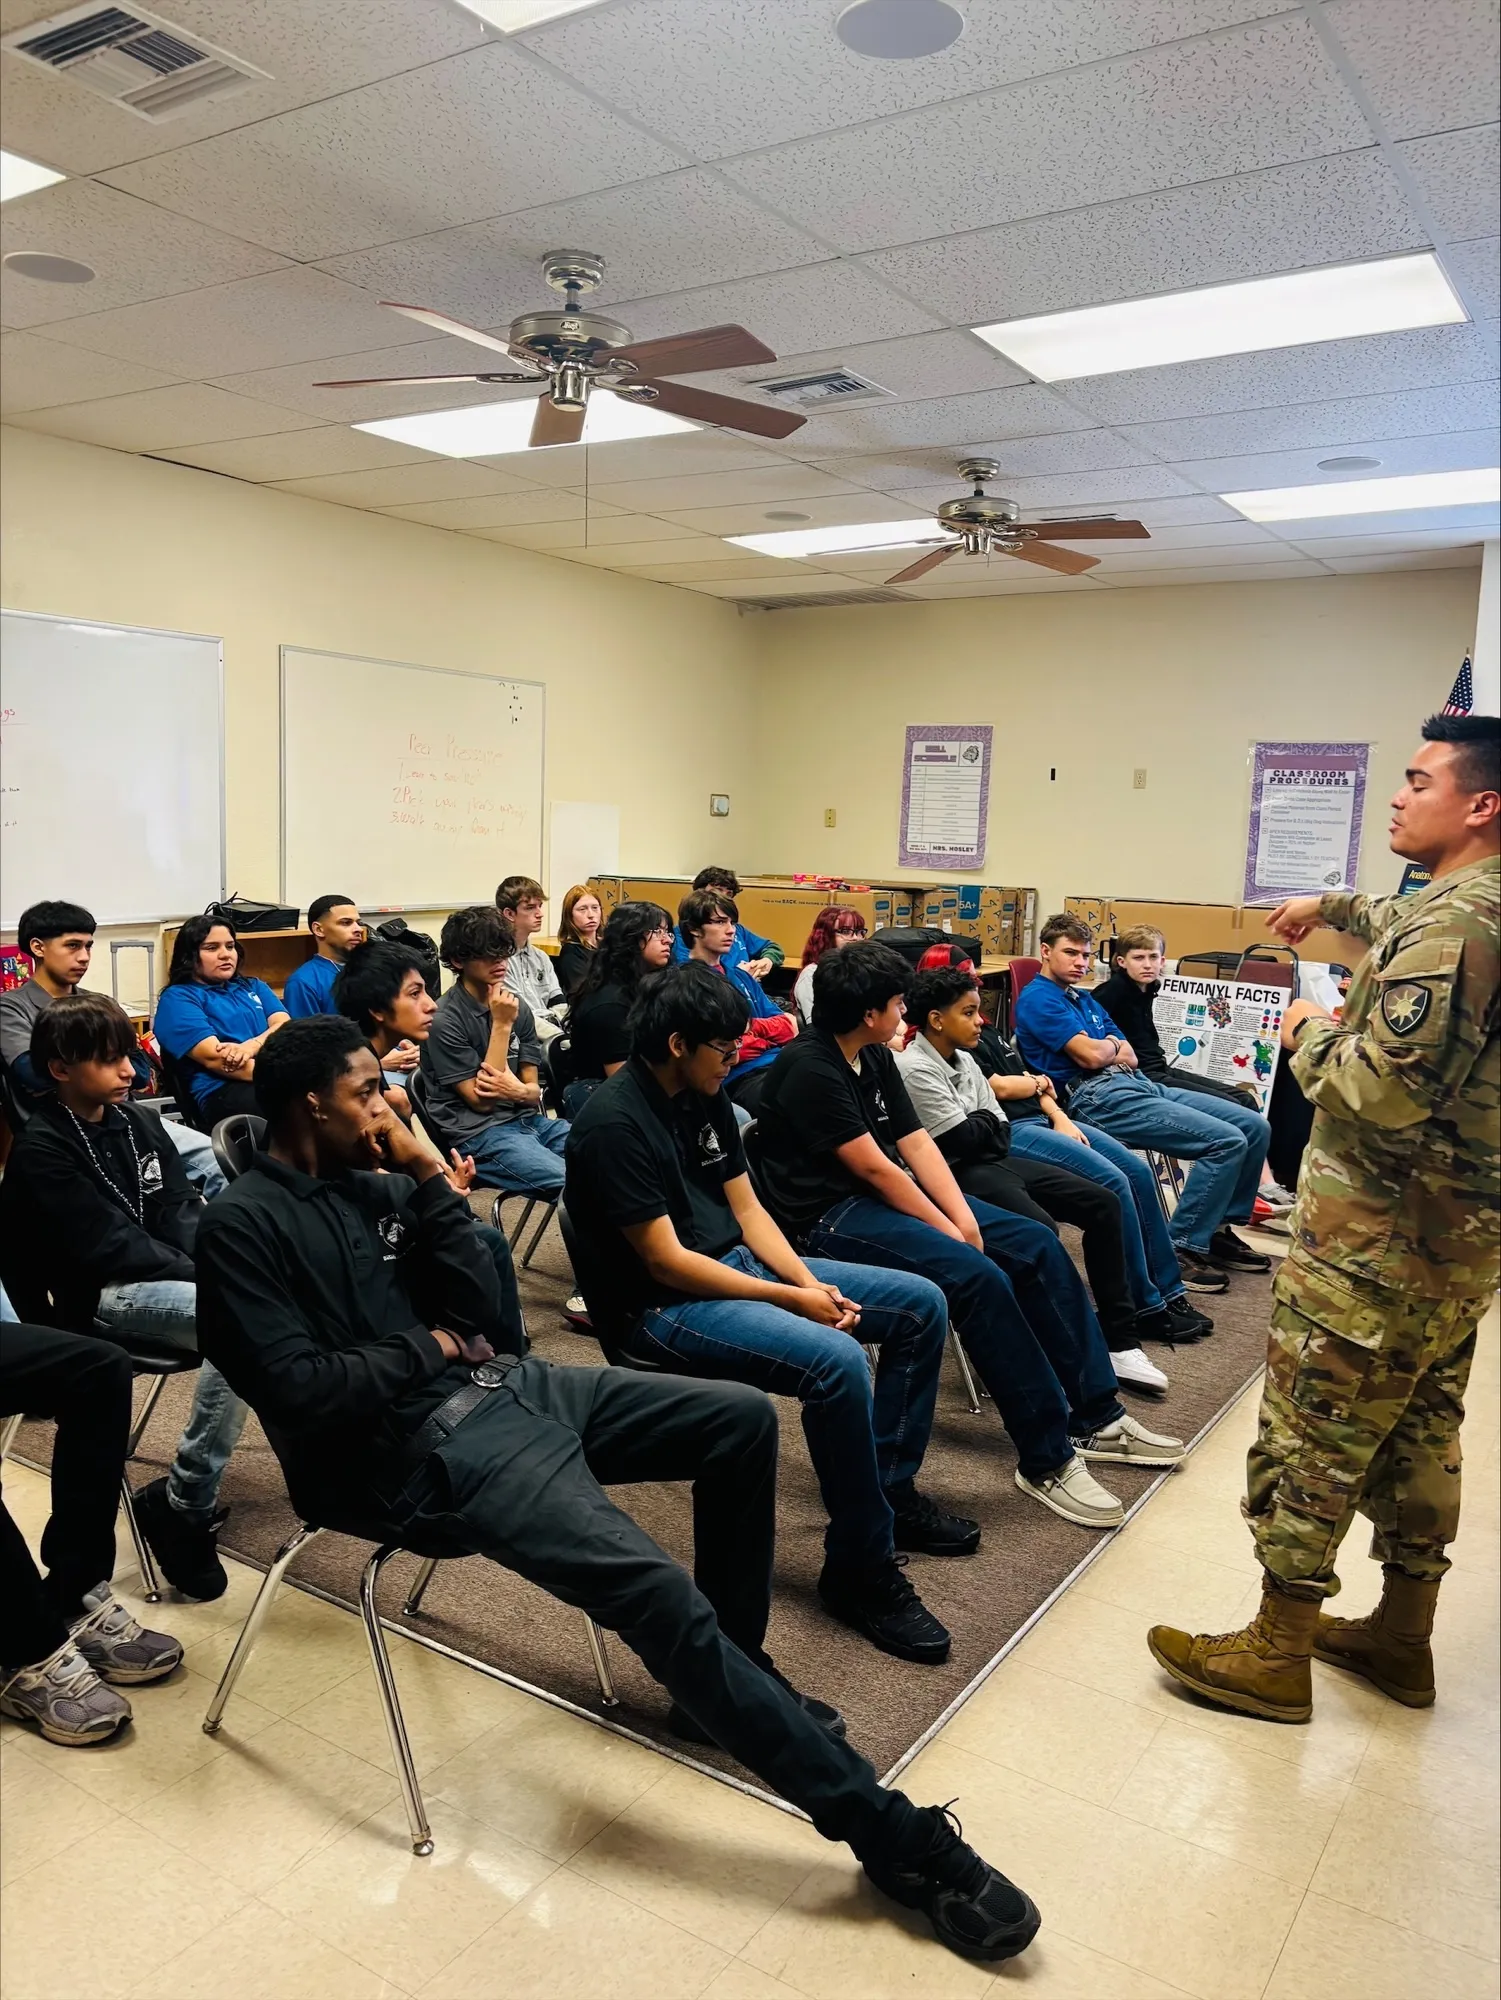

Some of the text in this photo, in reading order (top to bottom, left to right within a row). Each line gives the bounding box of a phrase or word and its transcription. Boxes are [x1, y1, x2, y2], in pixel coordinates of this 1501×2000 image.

[409, 733, 431, 755] Peer
[1273, 769, 1347, 778] CLASSROOM
[1269, 777, 1349, 786] PROCEDURES
[1162, 978, 1281, 1005] FENTANYL FACTS
